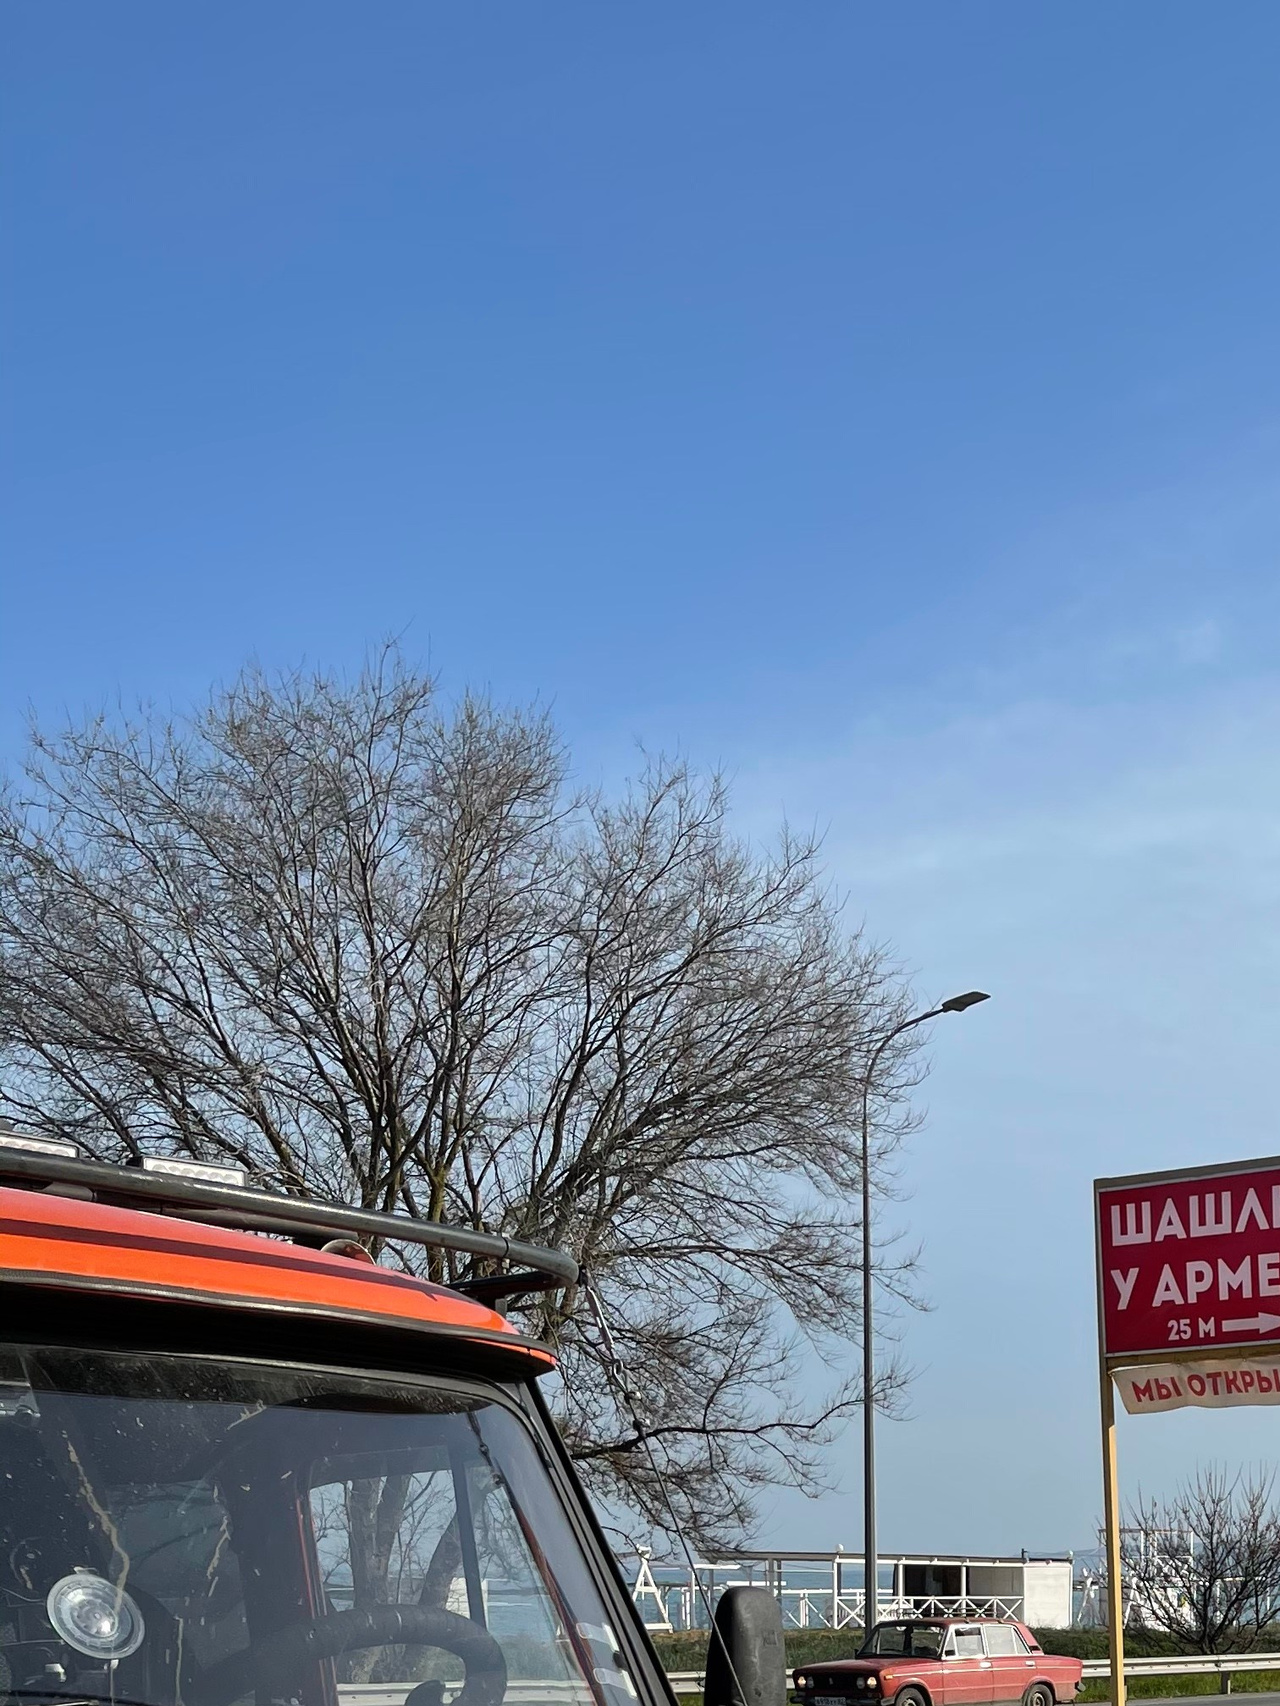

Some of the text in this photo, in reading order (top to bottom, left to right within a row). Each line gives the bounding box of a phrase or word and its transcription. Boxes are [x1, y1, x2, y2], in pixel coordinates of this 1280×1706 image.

[1110, 1267, 1139, 1310] У
[1167, 1316, 1215, 1340] 25 М
[1131, 1375, 1182, 1402] МЫ
